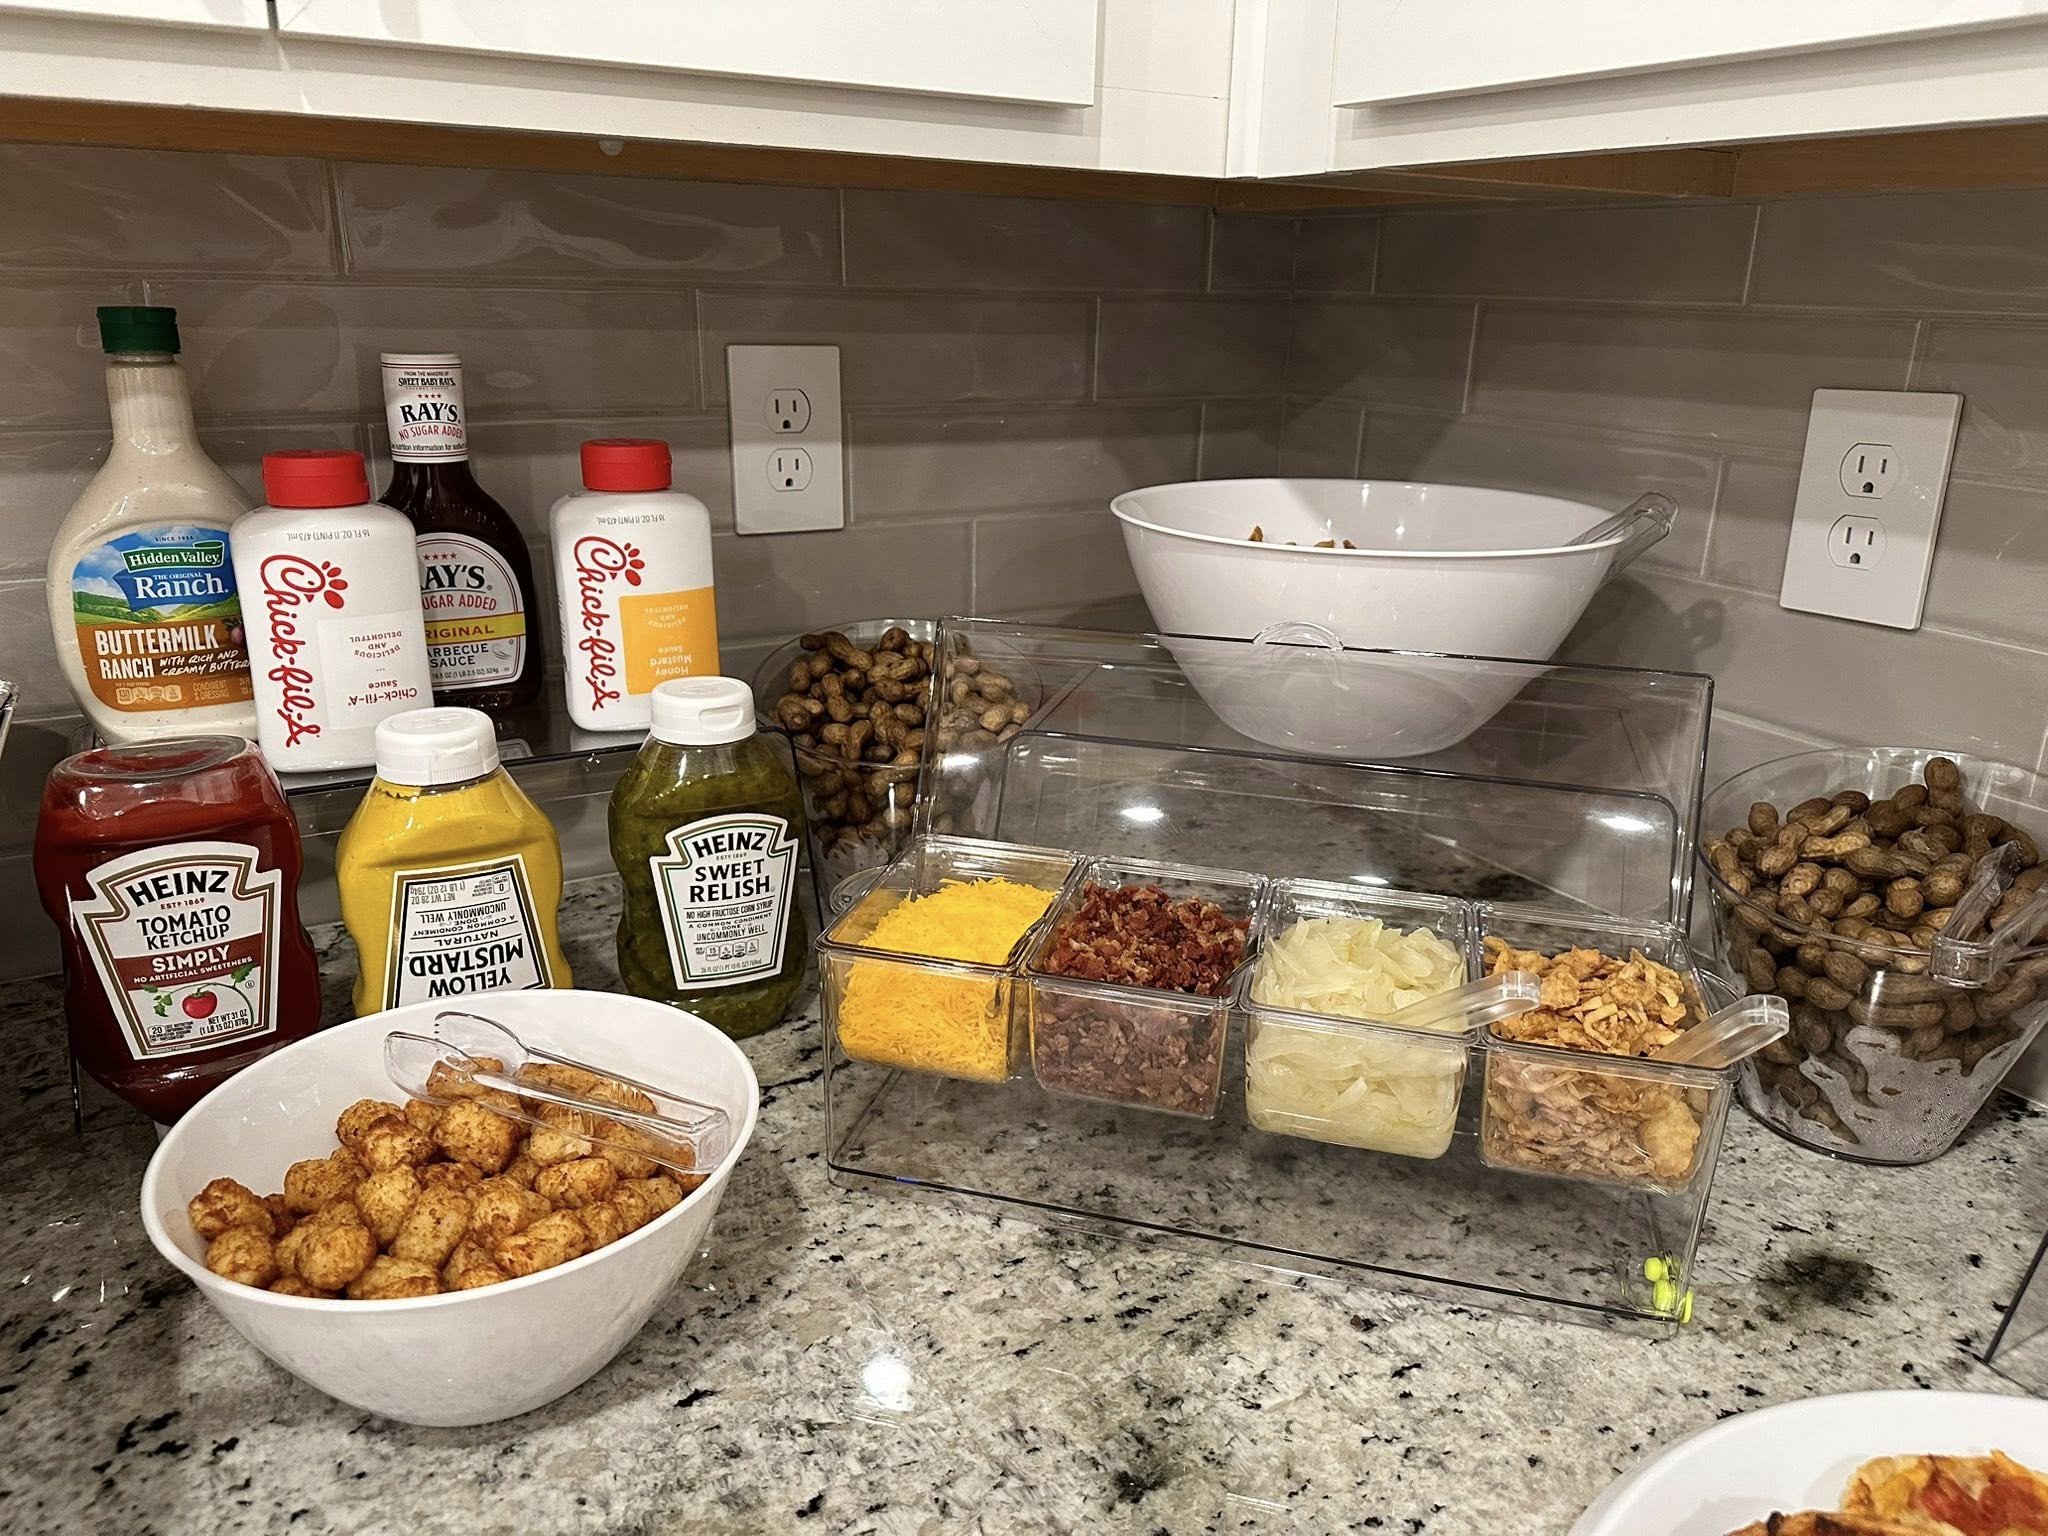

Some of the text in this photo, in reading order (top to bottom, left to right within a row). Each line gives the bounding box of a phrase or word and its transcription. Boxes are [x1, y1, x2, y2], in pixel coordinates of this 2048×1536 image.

[398, 378, 420, 387] SWEET
[420, 378, 438, 386] BABY
[400, 403, 458, 423] RAY'S
[398, 425, 463, 441] NO SUGAR ADDED
[128, 551, 220, 567] Hidden Valley
[420, 565, 485, 590] AY'S
[133, 573, 225, 599] Ranch
[422, 594, 497, 611] UGAR ADDED
[95, 624, 219, 656] BUTTERMILK
[349, 631, 402, 643] DELIGHTFUL
[425, 625, 495, 639] RIGINAL
[354, 644, 401, 658] DELICIOUS
[368, 642, 387, 650] AND
[427, 643, 489, 658] RBECUE
[658, 645, 683, 654] Sauce
[99, 650, 238, 680] RANCH WITH RICH AND
[430, 655, 475, 668] SAUCE
[650, 653, 692, 668] Mustard
[161, 665, 205, 676] CREAMY
[655, 666, 689, 676] Honey
[368, 680, 398, 689] Sauce
[349, 687, 418, 706] Chick-fil-A
[691, 831, 767, 858] HEINZ
[695, 858, 765, 882] SWEET
[125, 870, 230, 907] HEINZ
[410, 886, 426, 895] 794g
[427, 884, 439, 894] OZ)
[441, 884, 448, 893] 12
[449, 883, 458, 892] LB
[460, 880, 466, 891] (1
[689, 875, 770, 903] RELISH
[184, 897, 206, 906] 1869
[411, 893, 456, 905] NET WT 28 OZ
[420, 902, 506, 924] UNCOMMONLY WELL
[686, 900, 773, 919] NO HIGH FRUCTOSE CORN SYRUP
[137, 905, 231, 936] TOMATO
[454, 918, 478, 926] DONE
[467, 917, 506, 929] COMMON
[734, 912, 772, 924] CONDIMENT
[146, 923, 230, 951] KETCHUP
[412, 925, 463, 936] CONDIMENT
[434, 929, 499, 947] NATURAL
[697, 924, 765, 941] UNCOMMONLY WELL
[152, 944, 230, 973] SIMPLY
[409, 938, 524, 977] MUSTARD
[149, 969, 198, 982] ARTIFICIAL
[200, 956, 253, 974] SWEETENERS
[428, 967, 512, 998] YELLOW
[208, 1009, 247, 1025] NET WT 31 OZ
[200, 1026, 206, 1036] (1
[207, 1025, 215, 1033] LB
[215, 1023, 223, 1031] 15
[223, 1020, 234, 1030] OZ)
